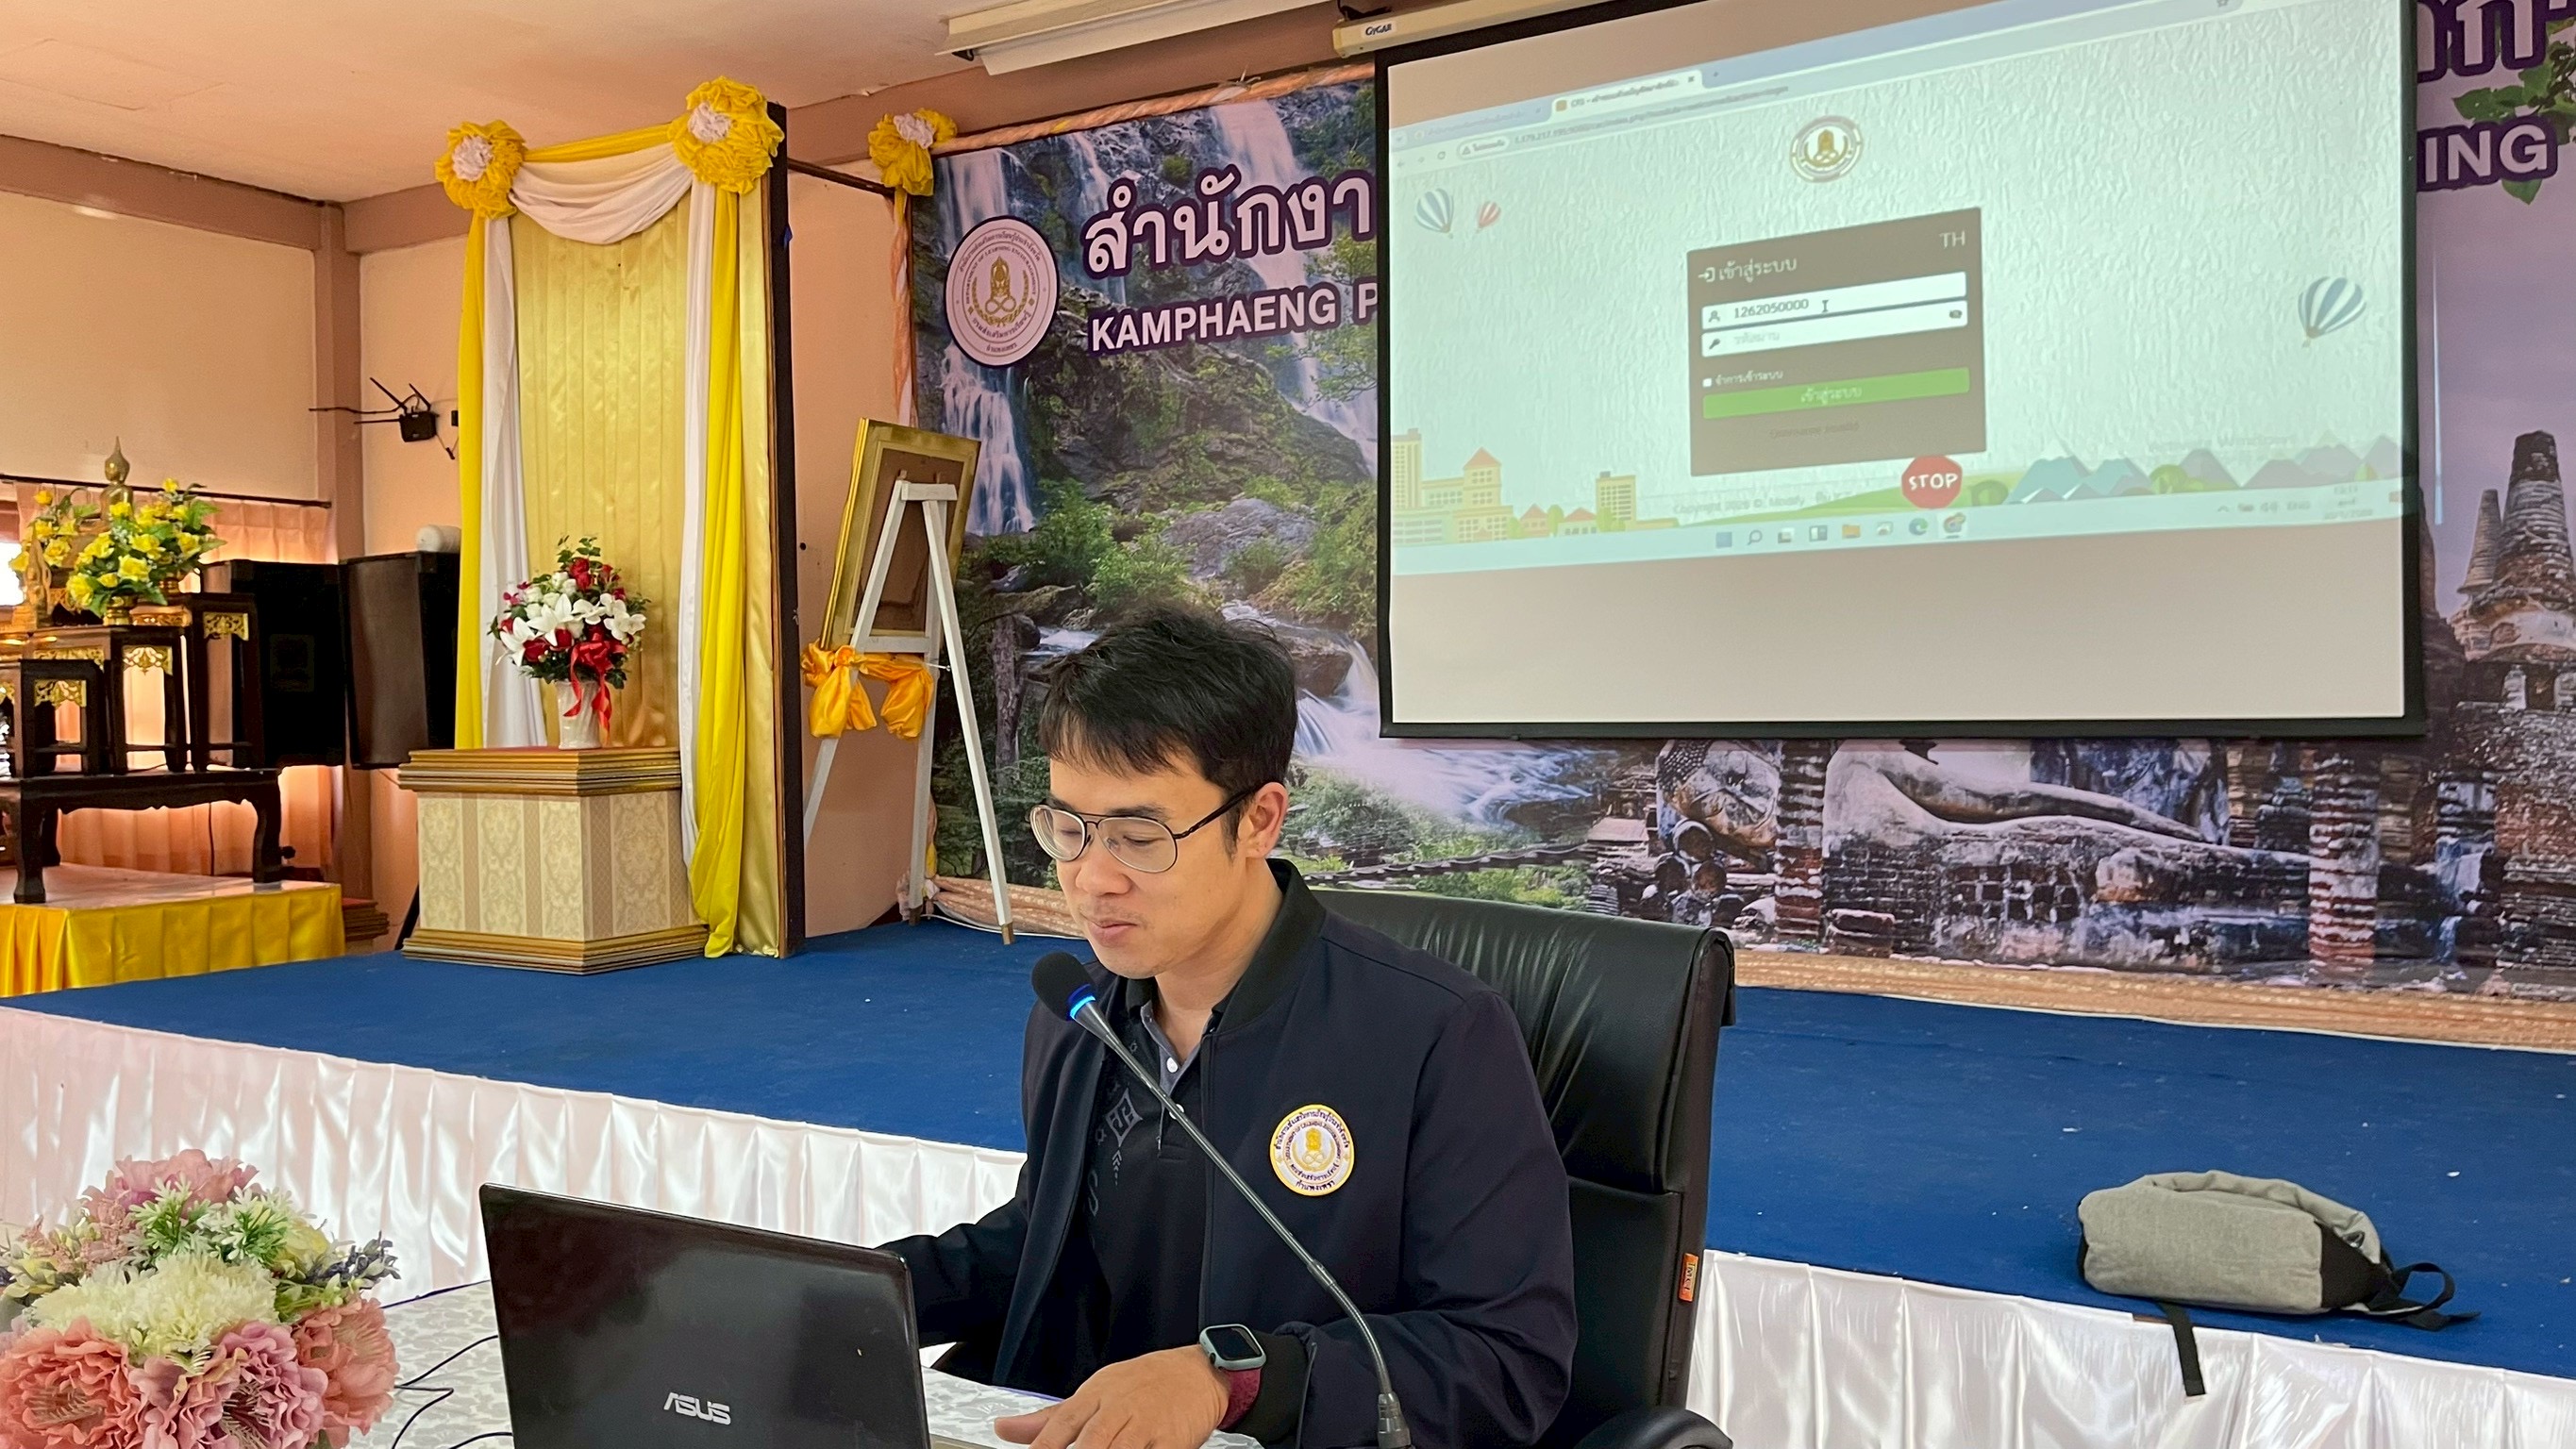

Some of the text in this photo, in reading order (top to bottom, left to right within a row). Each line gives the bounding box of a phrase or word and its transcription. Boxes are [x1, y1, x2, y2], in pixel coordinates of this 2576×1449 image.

[1085, 172, 1371, 274] สำนักงา
[1939, 230, 1966, 249] TH
[1718, 257, 1798, 283] เข้าสู่ระบบ
[1092, 288, 1337, 352] KAMPHAENG
[1733, 298, 1809, 319] 1262050000
[1800, 386, 1863, 406] เข้าสู่ระบบ
[1908, 474, 1958, 491] STOP
[663, 1391, 731, 1425] ASUS
